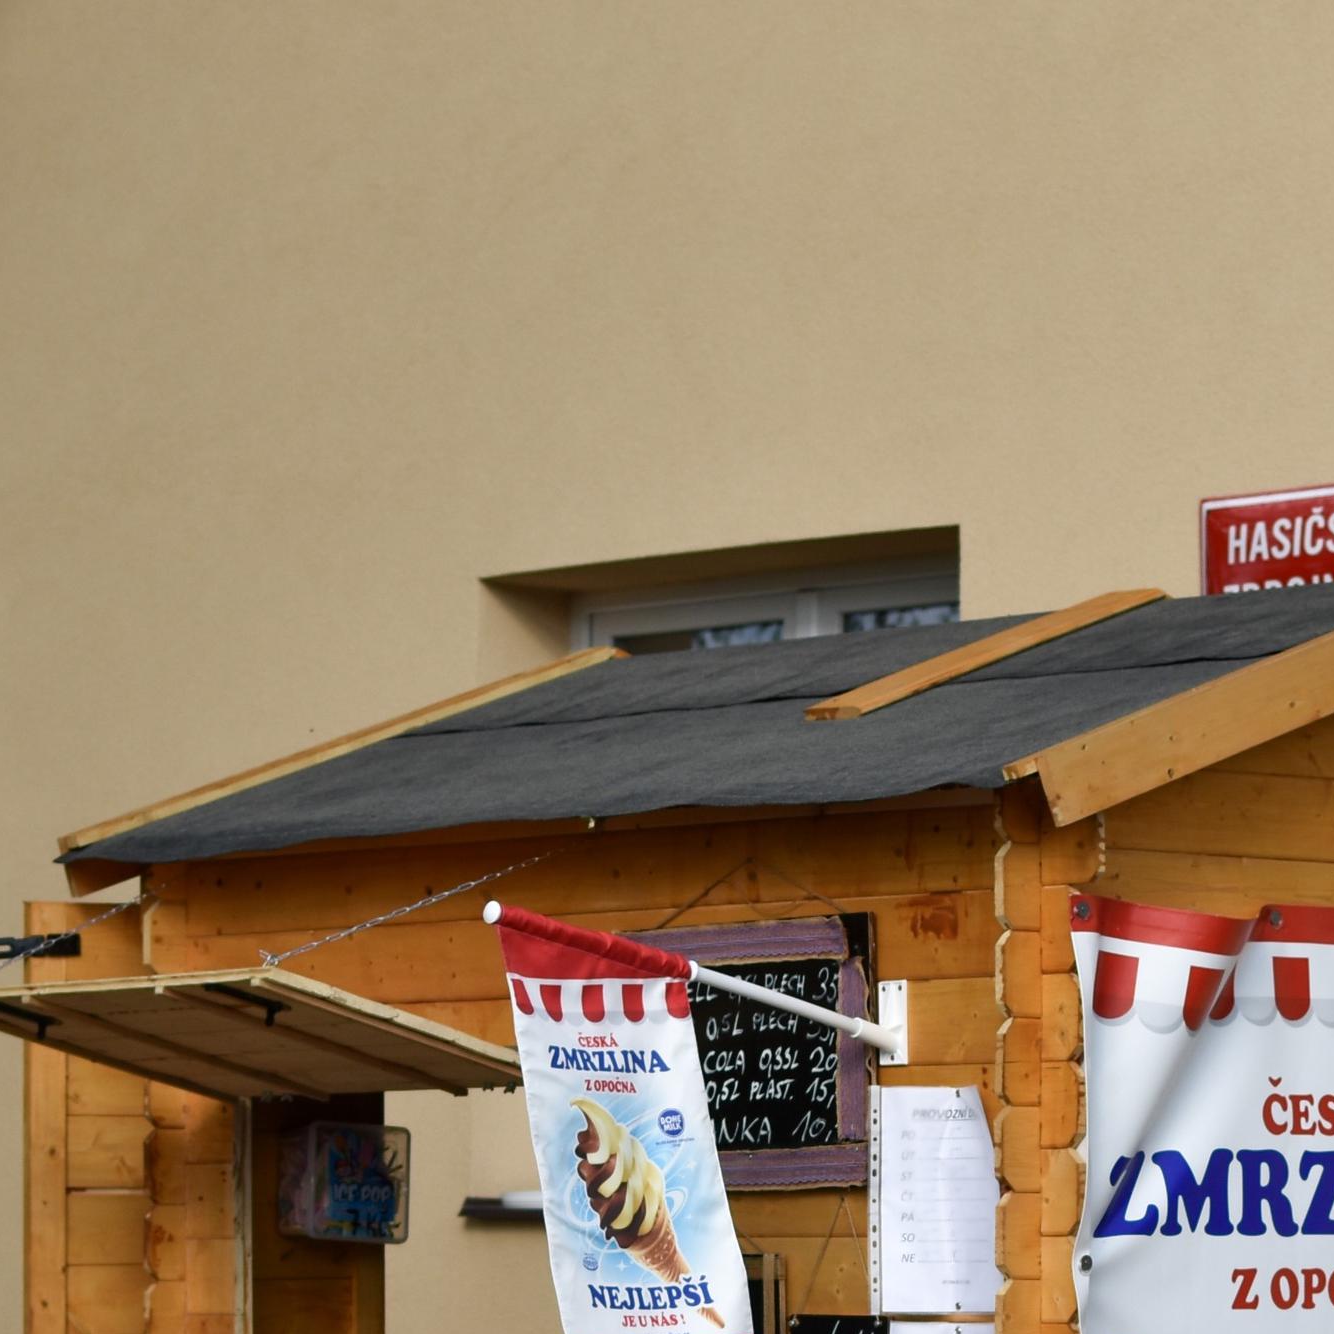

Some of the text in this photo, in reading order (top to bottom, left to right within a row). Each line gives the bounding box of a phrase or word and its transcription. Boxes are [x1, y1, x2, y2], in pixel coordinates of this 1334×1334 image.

[753, 1010, 798, 1035] PLECH
[578, 1032, 618, 1048] ČESKÁ
[548, 1045, 671, 1074] ZMRZLINA
[703, 1050, 746, 1075] COLA
[584, 1076, 637, 1094] Z OPOČNA
[718, 1115, 771, 1144] NKA
[901, 1233, 915, 1242] SO
[901, 1253, 915, 1264] NE
[587, 1275, 714, 1310] NEJLEPŠÍ
[1231, 1268, 1259, 1310] Z
[622, 1315, 637, 1327] JE
[639, 1315, 648, 1327] U
[650, 1311, 678, 1327] NÁS
